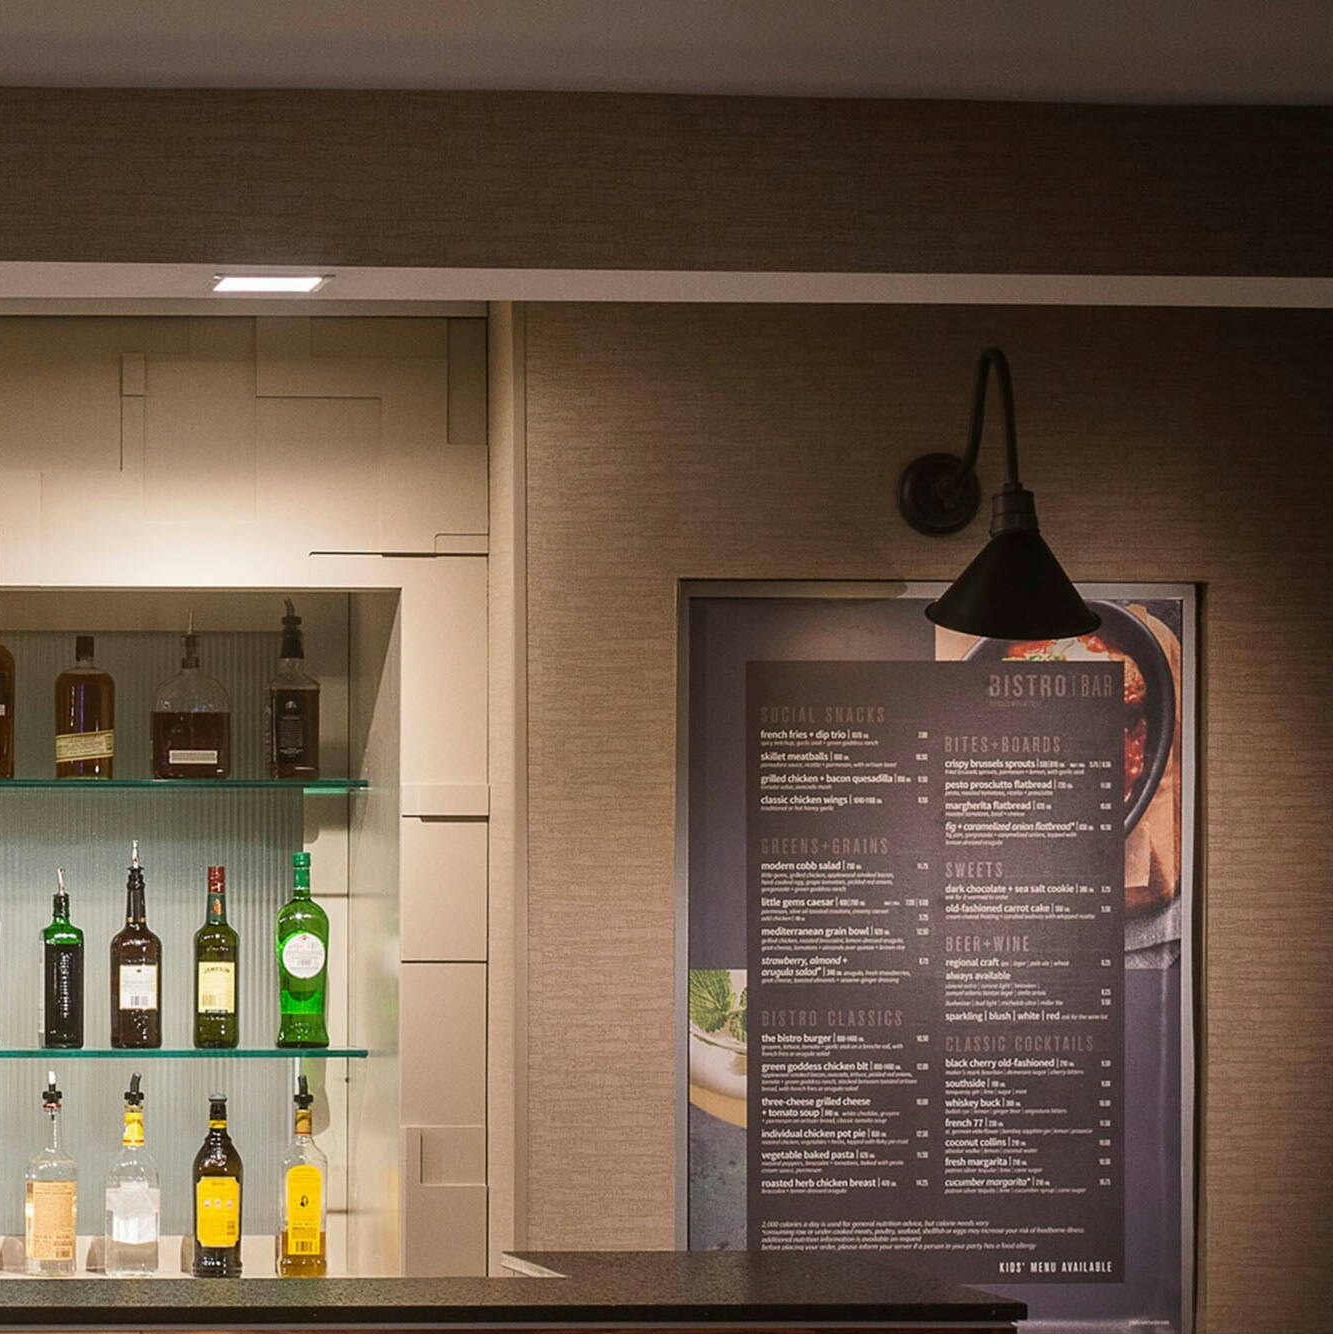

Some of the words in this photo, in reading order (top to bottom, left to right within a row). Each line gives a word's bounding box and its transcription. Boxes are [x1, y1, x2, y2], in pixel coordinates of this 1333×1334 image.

[989, 675, 1066, 697] BISTRO
[1080, 675, 1112, 697] BAR
[761, 707, 815, 723] SOCIAL
[825, 706, 885, 723] SNACKS
[761, 730, 788, 739] french
[789, 730, 808, 740] fries
[815, 730, 830, 741] dip
[831, 730, 847, 739] trio
[761, 752, 786, 761] skillet
[787, 752, 829, 762] meatballs
[945, 759, 969, 770] crispy
[970, 759, 1004, 768] brussels
[1005, 760, 1036, 770] sprouts
[761, 774, 786, 785] grilled
[787, 774, 818, 783] chicken
[826, 774, 851, 783] bacon
[852, 774, 893, 785] quesadilla
[945, 781, 969, 791] pesto
[1014, 780, 1052, 789] flatbread
[761, 796, 788, 805] classic
[789, 795, 822, 805] chicken
[823, 795, 848, 806] wings
[945, 801, 991, 812] margherita
[993, 801, 1031, 810] flatbread
[761, 861, 795, 870] modern
[796, 861, 818, 870] cobb
[819, 861, 841, 870] salad
[945, 862, 1003, 878] SWEETS
[945, 884, 965, 893] dark
[966, 884, 1007, 893] chocolate
[1030, 884, 1046, 893] salt
[1047, 884, 1074, 893] cookie
[761, 898, 781, 907] little
[782, 900, 805, 909] gems
[807, 899, 835, 907] caesar
[1004, 905, 1029, 914] carrot
[1030, 904, 1050, 914] cake
[761, 927, 824, 936] mediterranean
[825, 926, 847, 938] grain
[848, 926, 870, 936] bowl
[945, 958, 979, 969] regional
[980, 958, 999, 967] craft
[946, 971, 973, 982] always
[975, 971, 1011, 980] available
[762, 1010, 817, 1027] BISTRO
[827, 1010, 903, 1027] CLASSICS
[945, 1012, 983, 1022] sparkling
[989, 1012, 1011, 1020] blush
[1017, 1012, 1040, 1020] white
[1046, 1011, 1060, 1020] red
[761, 1034, 776, 1043] the
[777, 1034, 802, 1043] bistro
[803, 1034, 832, 1045] burger
[945, 1036, 1006, 1052] CLASSIC
[1015, 1036, 1094, 1052] COCKTAILS
[761, 1064, 786, 1073] green
[787, 1063, 822, 1073] goddess
[823, 1062, 855, 1071] chicken
[945, 1059, 968, 1068] black
[969, 1058, 997, 1070] cherry
[816, 1097, 842, 1108] grilled
[842, 1097, 871, 1106] cheese
[945, 1099, 978, 1110] whiskey
[980, 1099, 1001, 1108] buck
[769, 1109, 799, 1117] tomato
[800, 1110, 820, 1118] soup
[945, 1118, 972, 1127] french
[973, 1119, 983, 1127] 77
[762, 1129, 803, 1138] individual
[803, 1129, 836, 1139] chicken
[837, 1130, 852, 1140] pot
[853, 1128, 866, 1140] pie
[945, 1139, 979, 1147] coconut
[980, 1138, 1007, 1147] collins
[761, 1150, 803, 1162] vegetable
[804, 1150, 830, 1160] baked
[831, 1151, 855, 1162] pasta
[945, 1158, 966, 1167] fresh
[967, 1158, 1008, 1169] margarita
[761, 1179, 794, 1188] roasted
[795, 1179, 815, 1187] herb
[816, 1178, 848, 1187] chicken
[849, 1178, 876, 1187] breast
[1031, 1262, 1056, 1273] MENU
[1062, 1262, 1111, 1272] AVAILABLE
